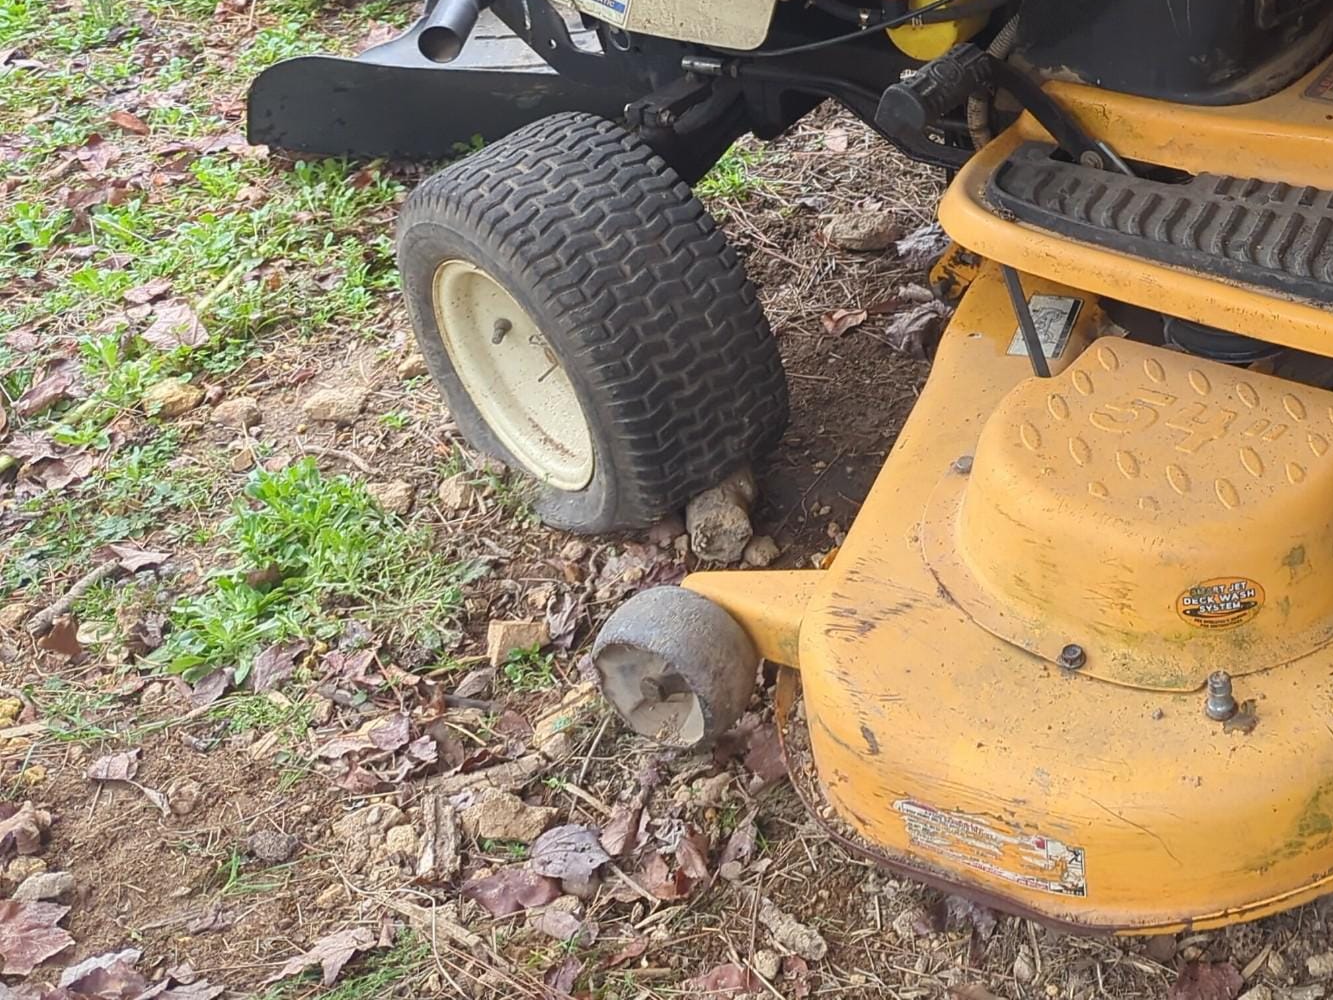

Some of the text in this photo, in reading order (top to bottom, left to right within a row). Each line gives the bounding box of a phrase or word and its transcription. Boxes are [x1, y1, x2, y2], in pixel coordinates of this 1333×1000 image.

[1229, 581, 1247, 592] JET
[1183, 589, 1255, 606] DECK WASH
[1199, 601, 1241, 613] SYSTEM
